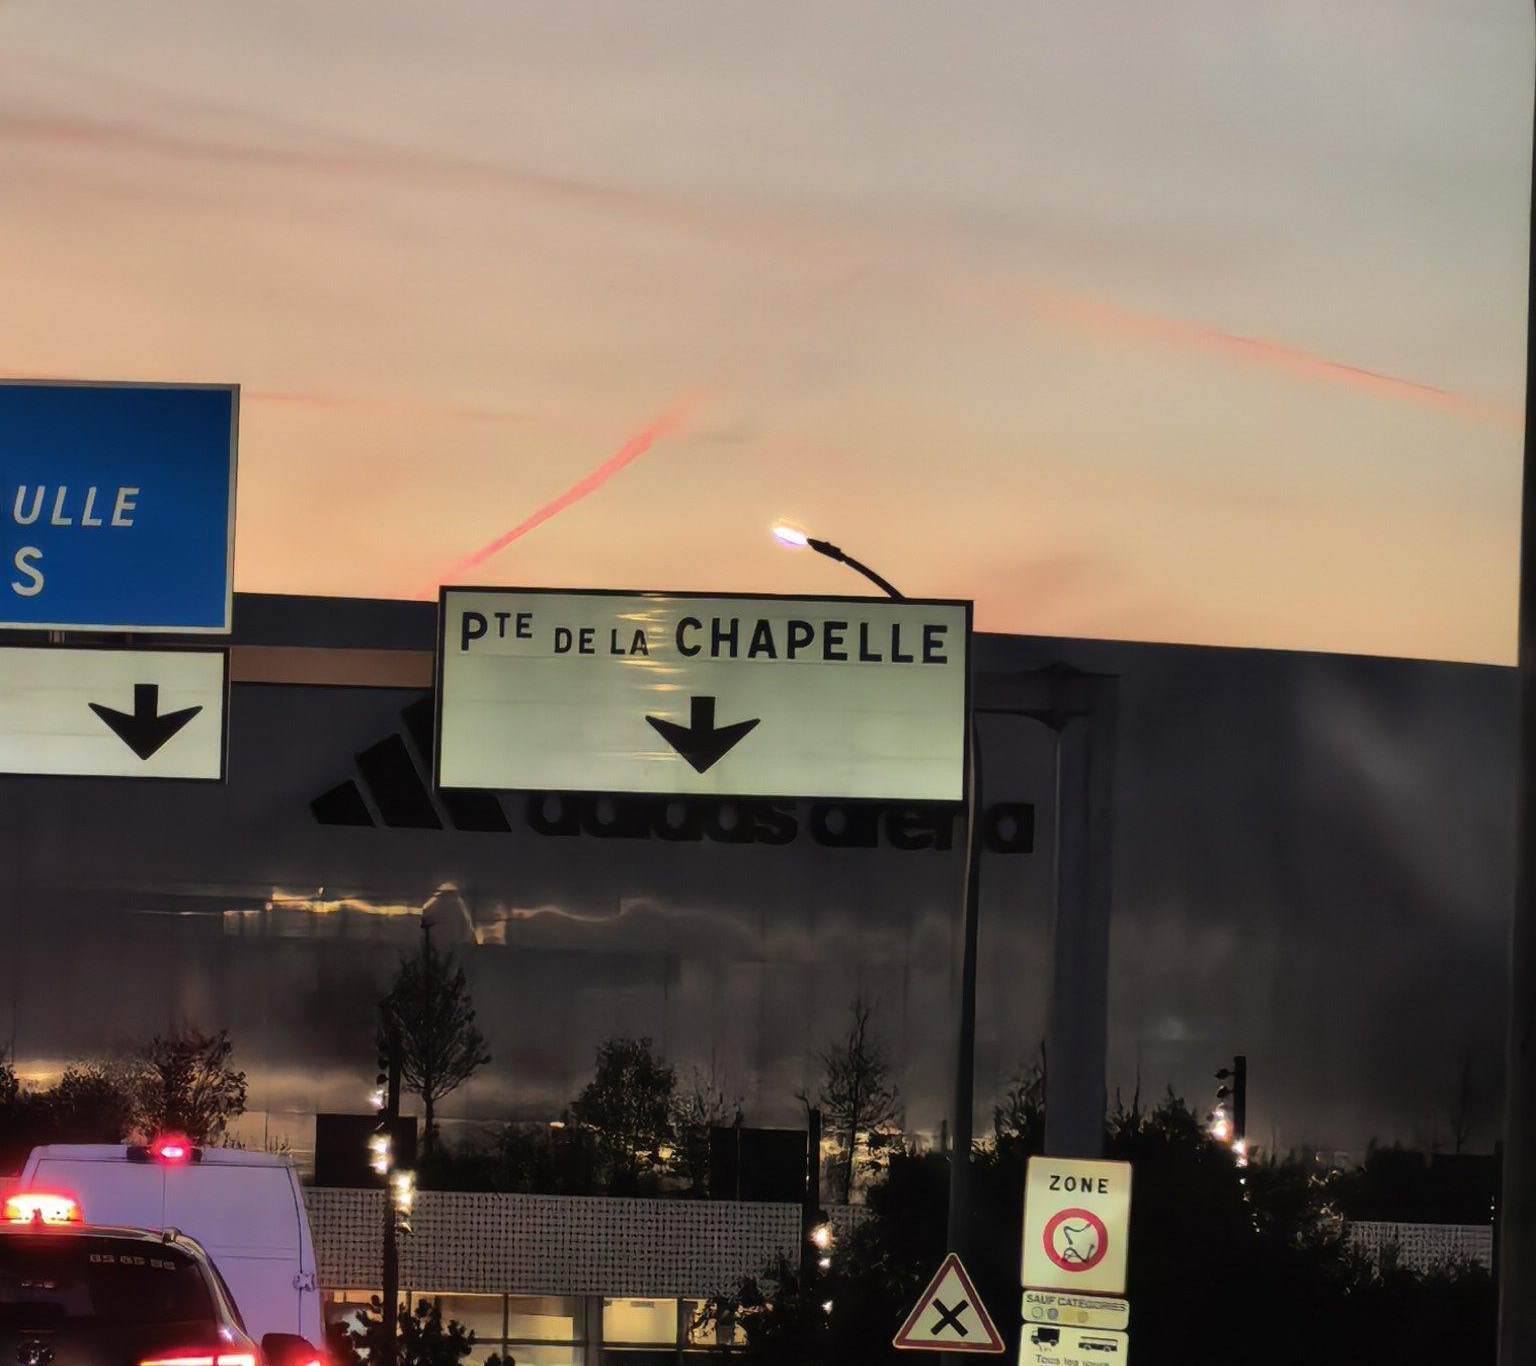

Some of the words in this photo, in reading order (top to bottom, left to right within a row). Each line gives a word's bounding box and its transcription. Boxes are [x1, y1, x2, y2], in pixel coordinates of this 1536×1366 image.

[554, 627, 596, 655] DE
[610, 629, 650, 657] LA
[674, 615, 949, 665] CHAPELLE
[1049, 1174, 1110, 1195] ZONE
[1026, 1294, 1056, 1305] SAUF
